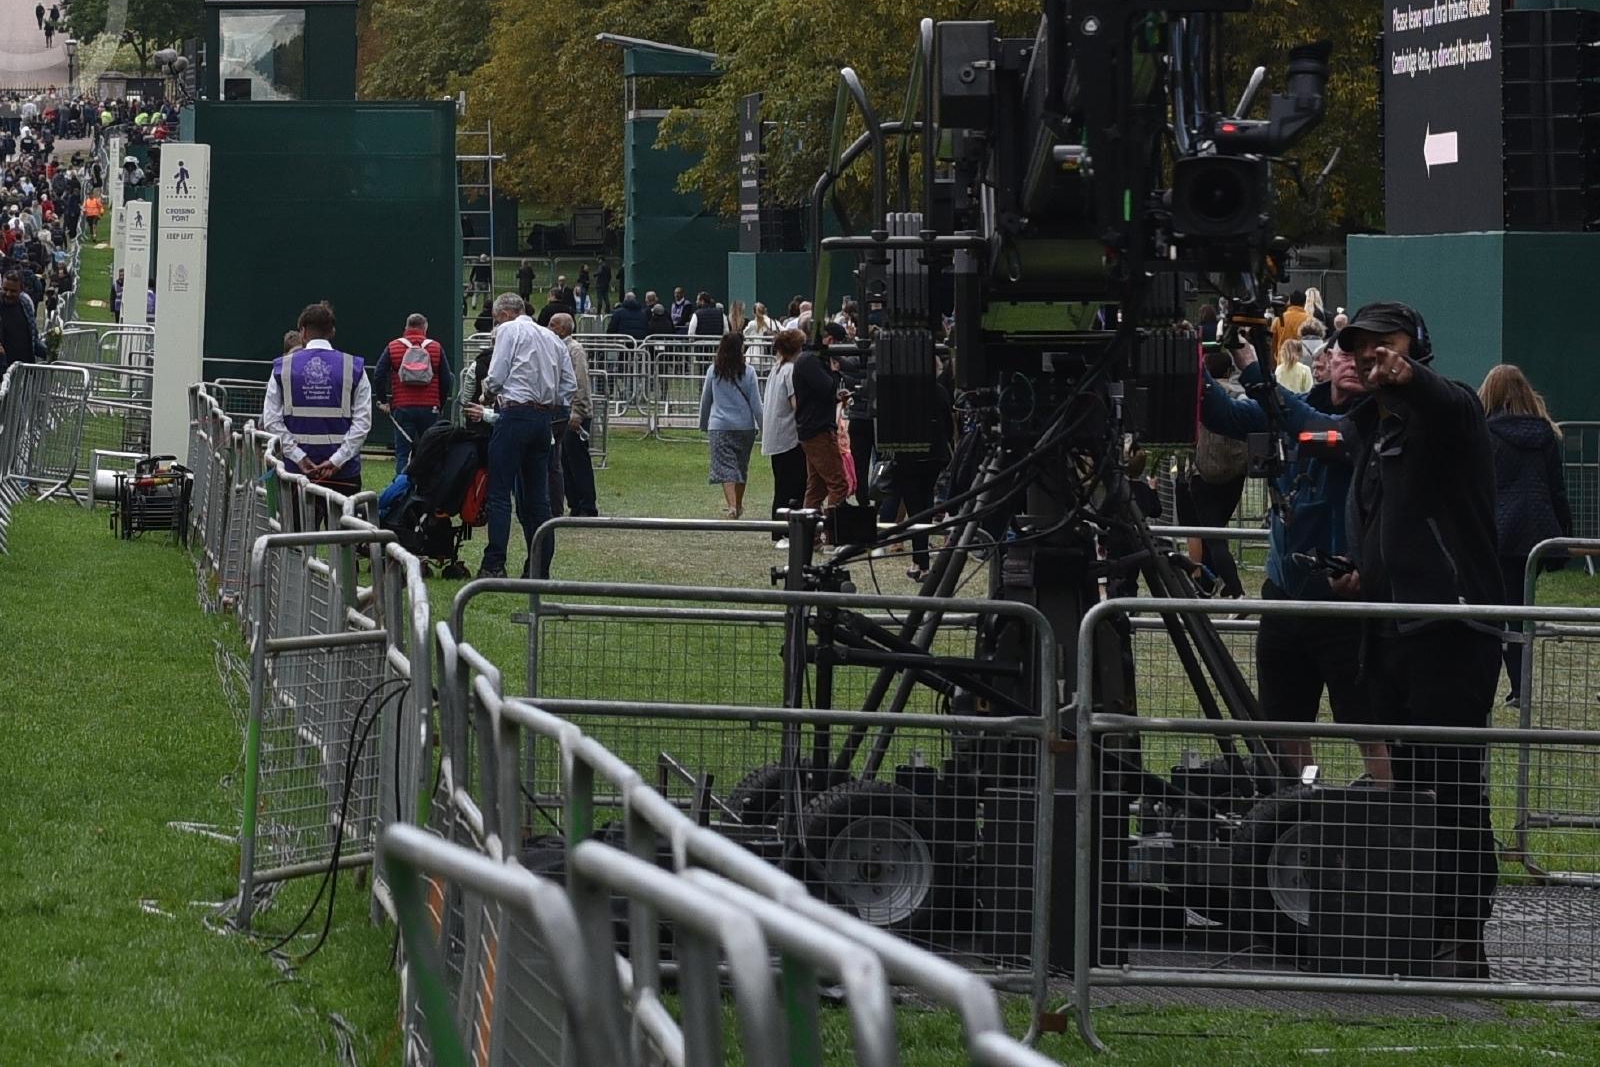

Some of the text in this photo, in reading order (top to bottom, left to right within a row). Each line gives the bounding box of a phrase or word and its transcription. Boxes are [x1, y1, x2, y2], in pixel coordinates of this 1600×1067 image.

[1392, 7, 1408, 34] Please
[1408, 3, 1422, 30] leave
[1422, 7, 1433, 35] your
[1392, 32, 1492, 78] Cambridge Gate, as directed by stewards
[165, 207, 196, 215] CROSSING
[171, 215, 189, 223] POINT
